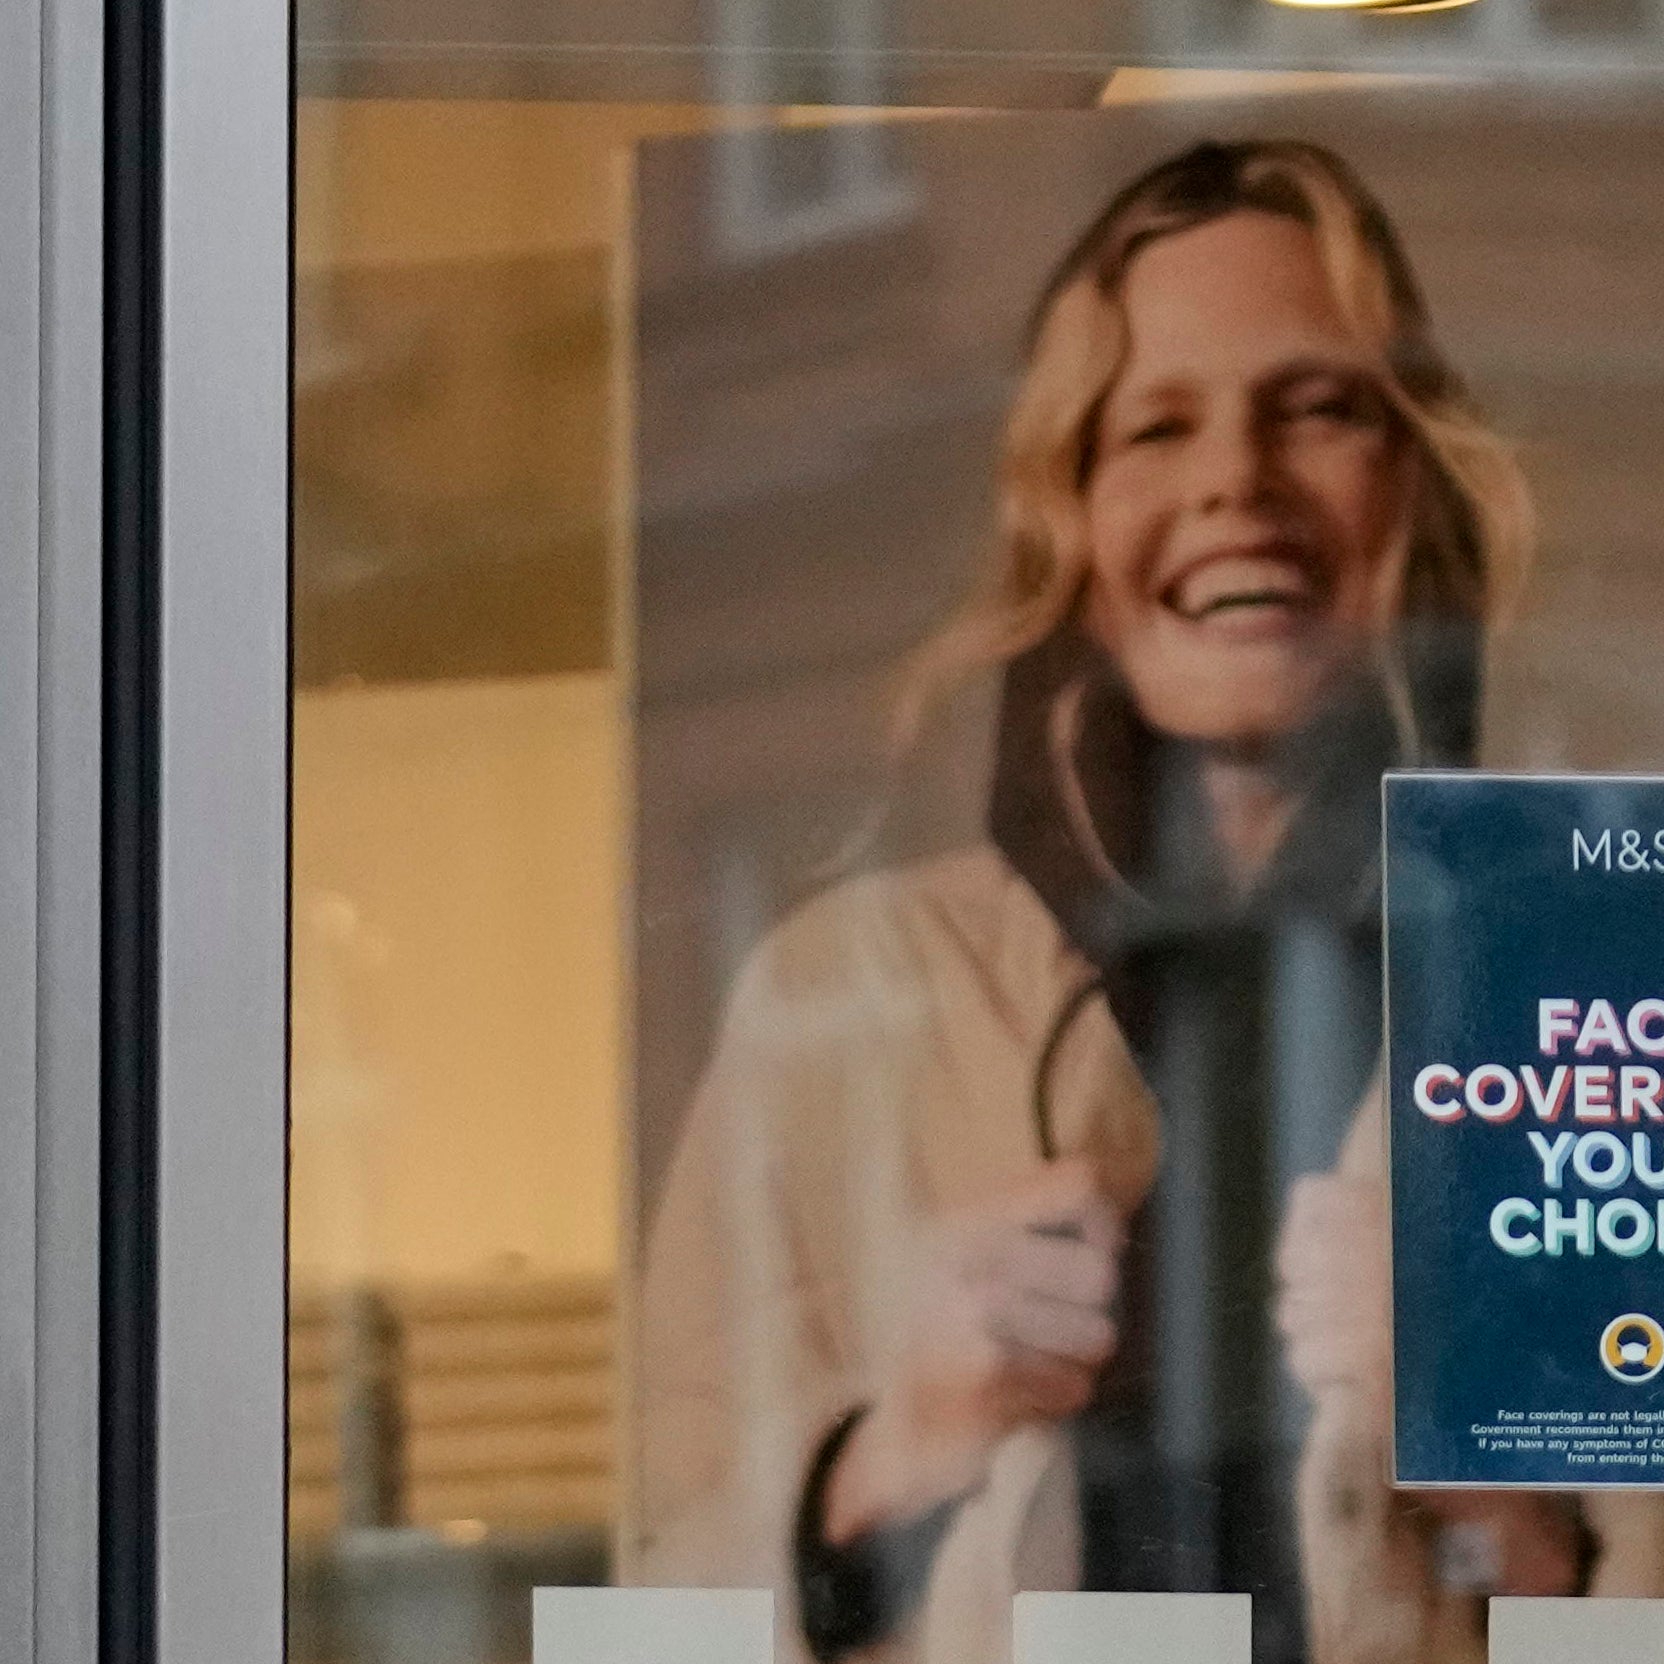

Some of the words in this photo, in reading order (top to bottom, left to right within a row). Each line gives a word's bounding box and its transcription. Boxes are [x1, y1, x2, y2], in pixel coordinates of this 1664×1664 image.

[1497, 1409, 1525, 1421] Face
[1528, 1409, 1584, 1423] coverings
[1588, 1411, 1606, 1421] are
[1610, 1410, 1630, 1421] not
[1471, 1423, 1542, 1435] Government
[1545, 1423, 1620, 1435] recommends
[1623, 1424, 1653, 1435] them
[1478, 1437, 1487, 1449] If
[1490, 1439, 1513, 1451] you
[1516, 1438, 1545, 1449] have
[1548, 1440, 1569, 1451] any
[1573, 1438, 1632, 1451] symptoms
[1636, 1437, 1649, 1449] of
[1567, 1452, 1595, 1463] from
[1599, 1452, 1648, 1465] entering
